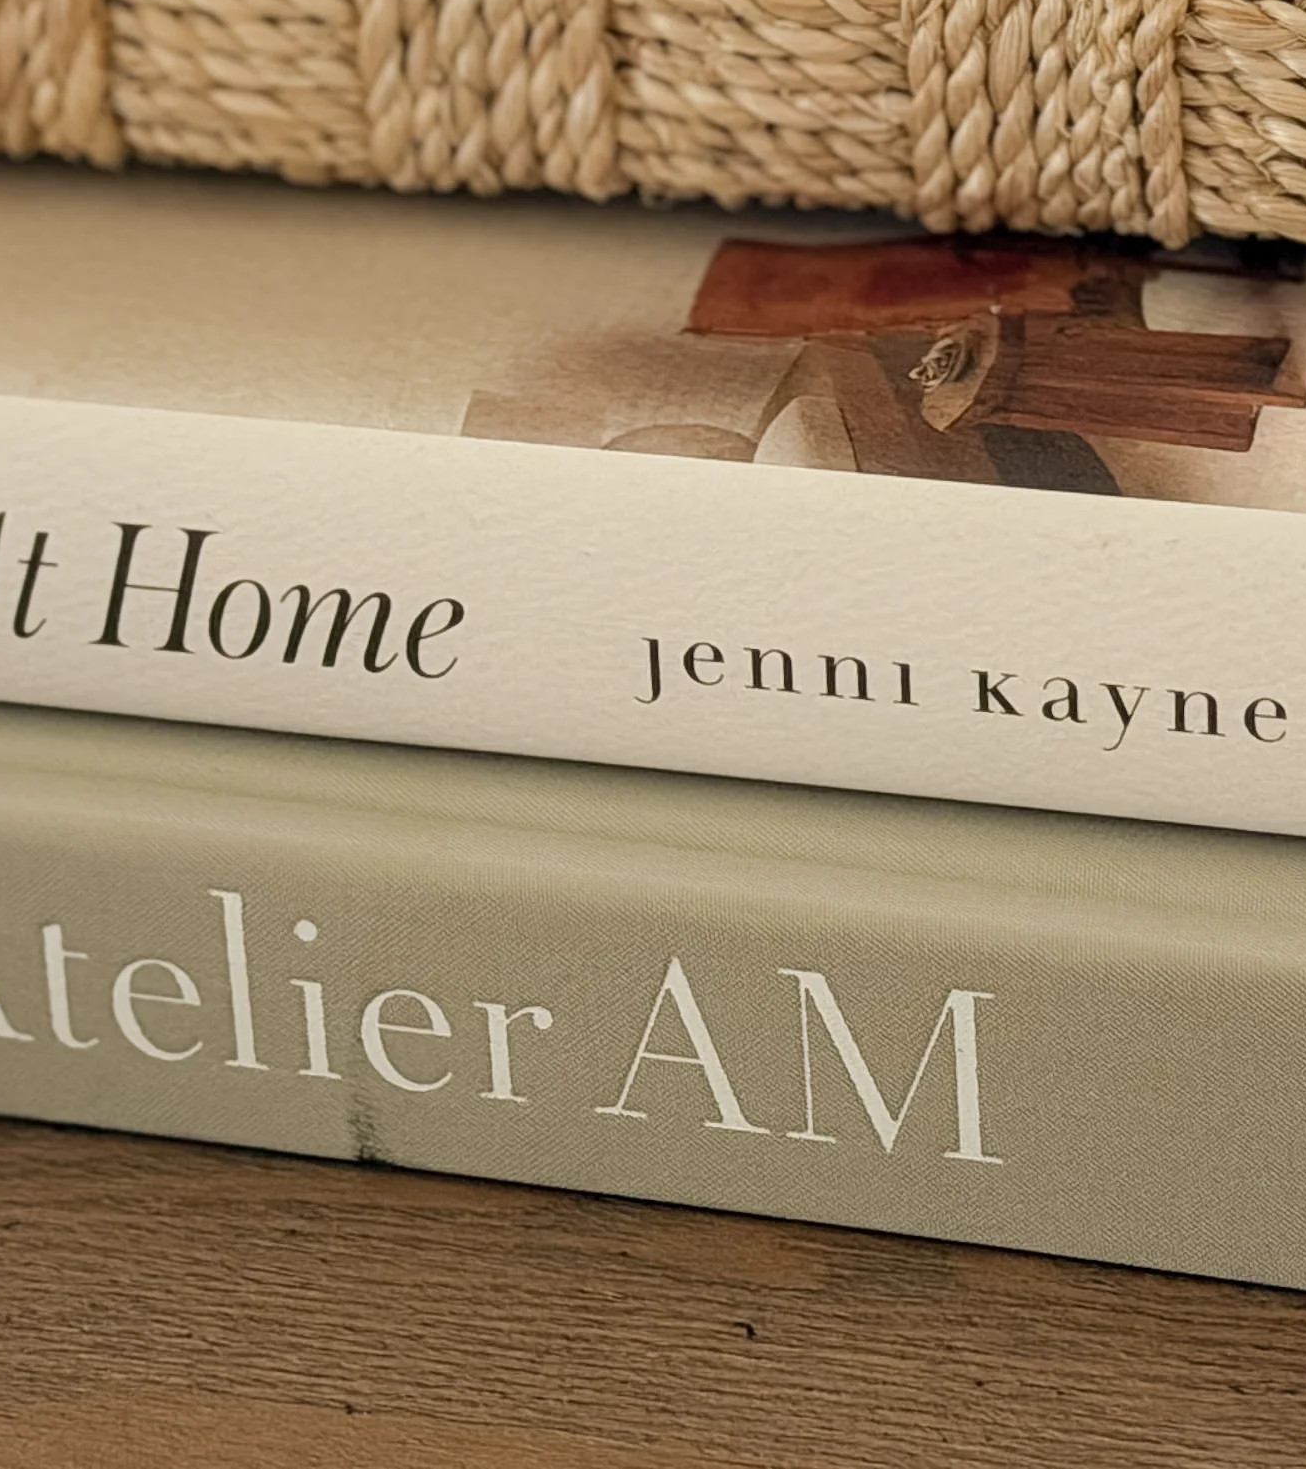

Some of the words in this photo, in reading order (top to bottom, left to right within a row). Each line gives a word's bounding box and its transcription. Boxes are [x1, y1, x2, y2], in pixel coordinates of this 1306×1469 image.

[89, 520, 466, 679] Home
[634, 636, 920, 707] jenni
[970, 668, 1288, 751] kayne
[593, 956, 1004, 1166] AM
